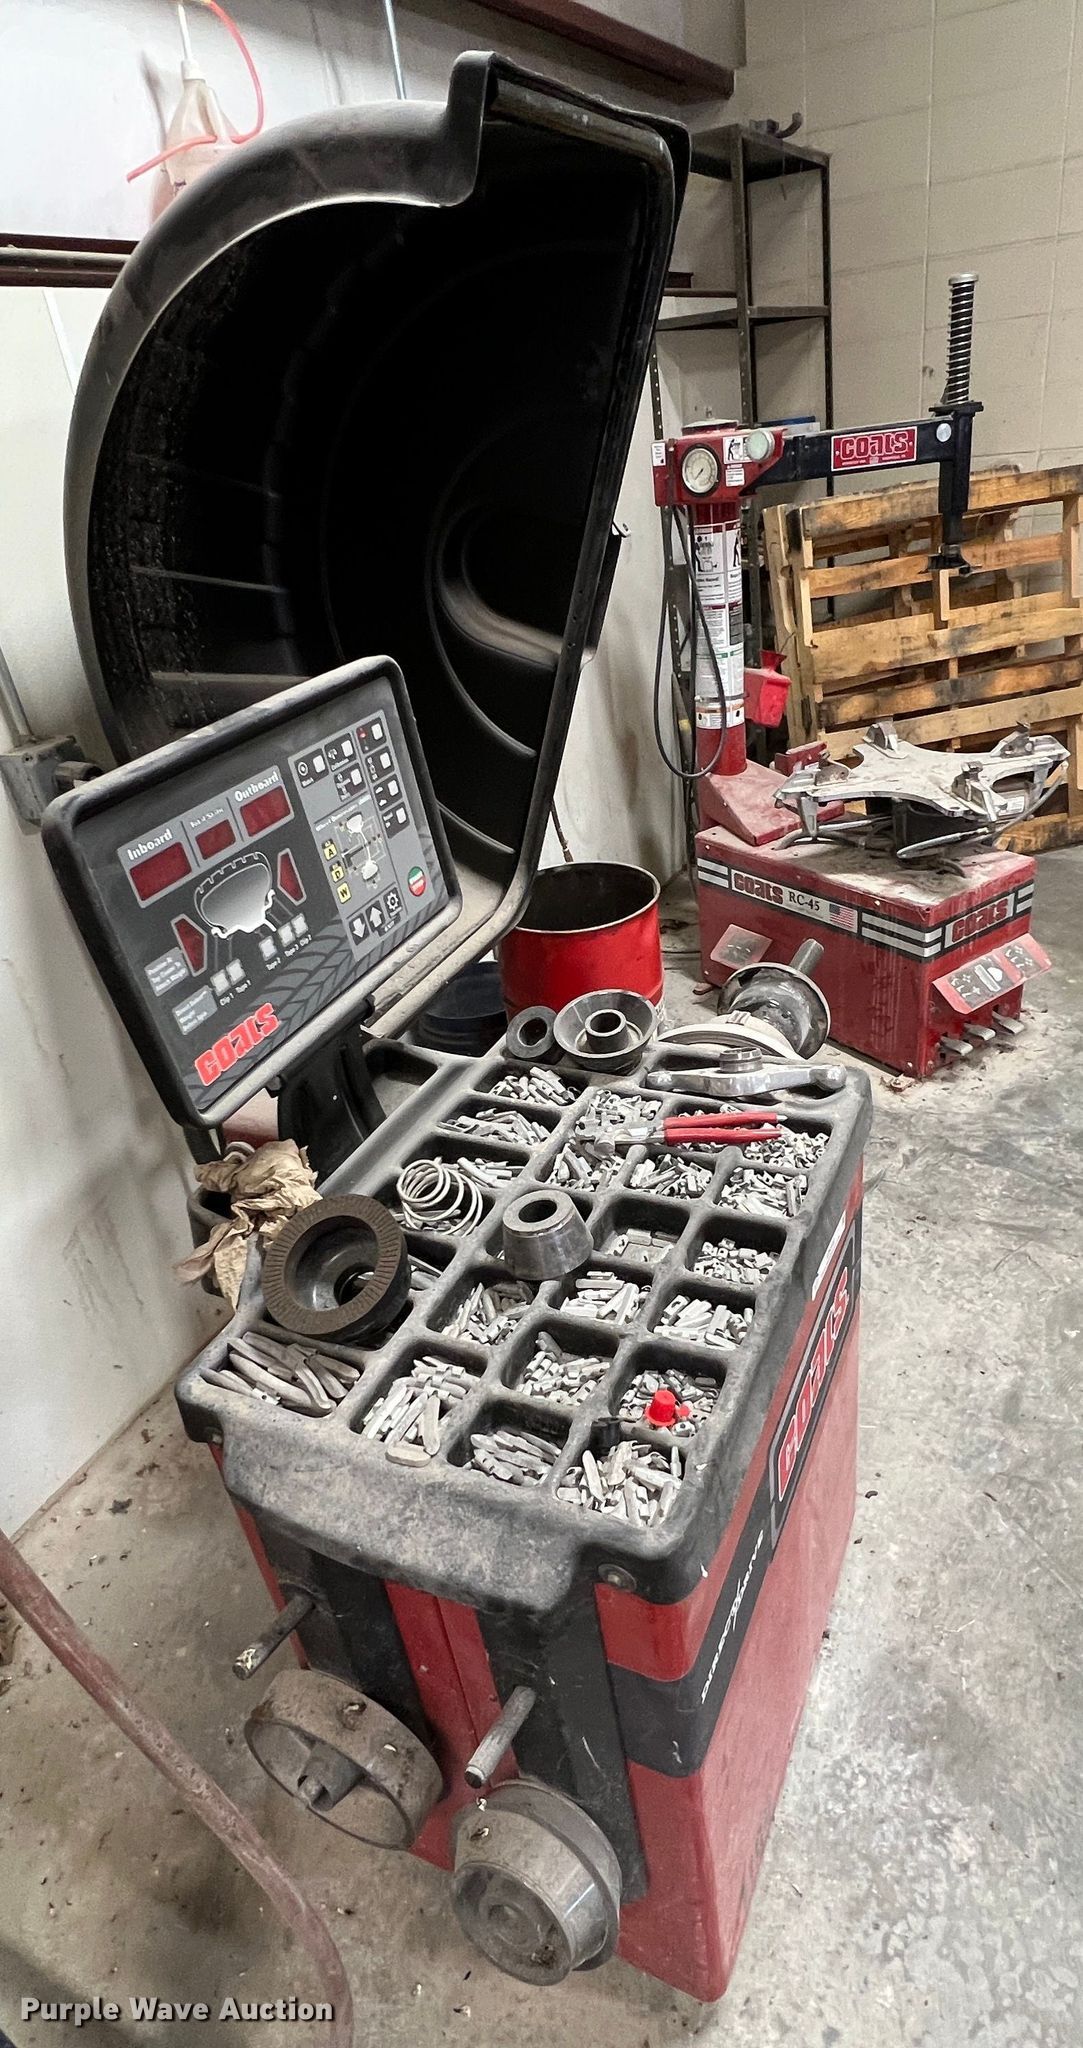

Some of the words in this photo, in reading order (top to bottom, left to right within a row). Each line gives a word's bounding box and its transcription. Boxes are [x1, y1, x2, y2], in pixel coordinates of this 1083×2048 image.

[234, 771, 279, 802] Outboard
[127, 828, 174, 861] Inboard
[788, 890, 820, 911] RC-45
